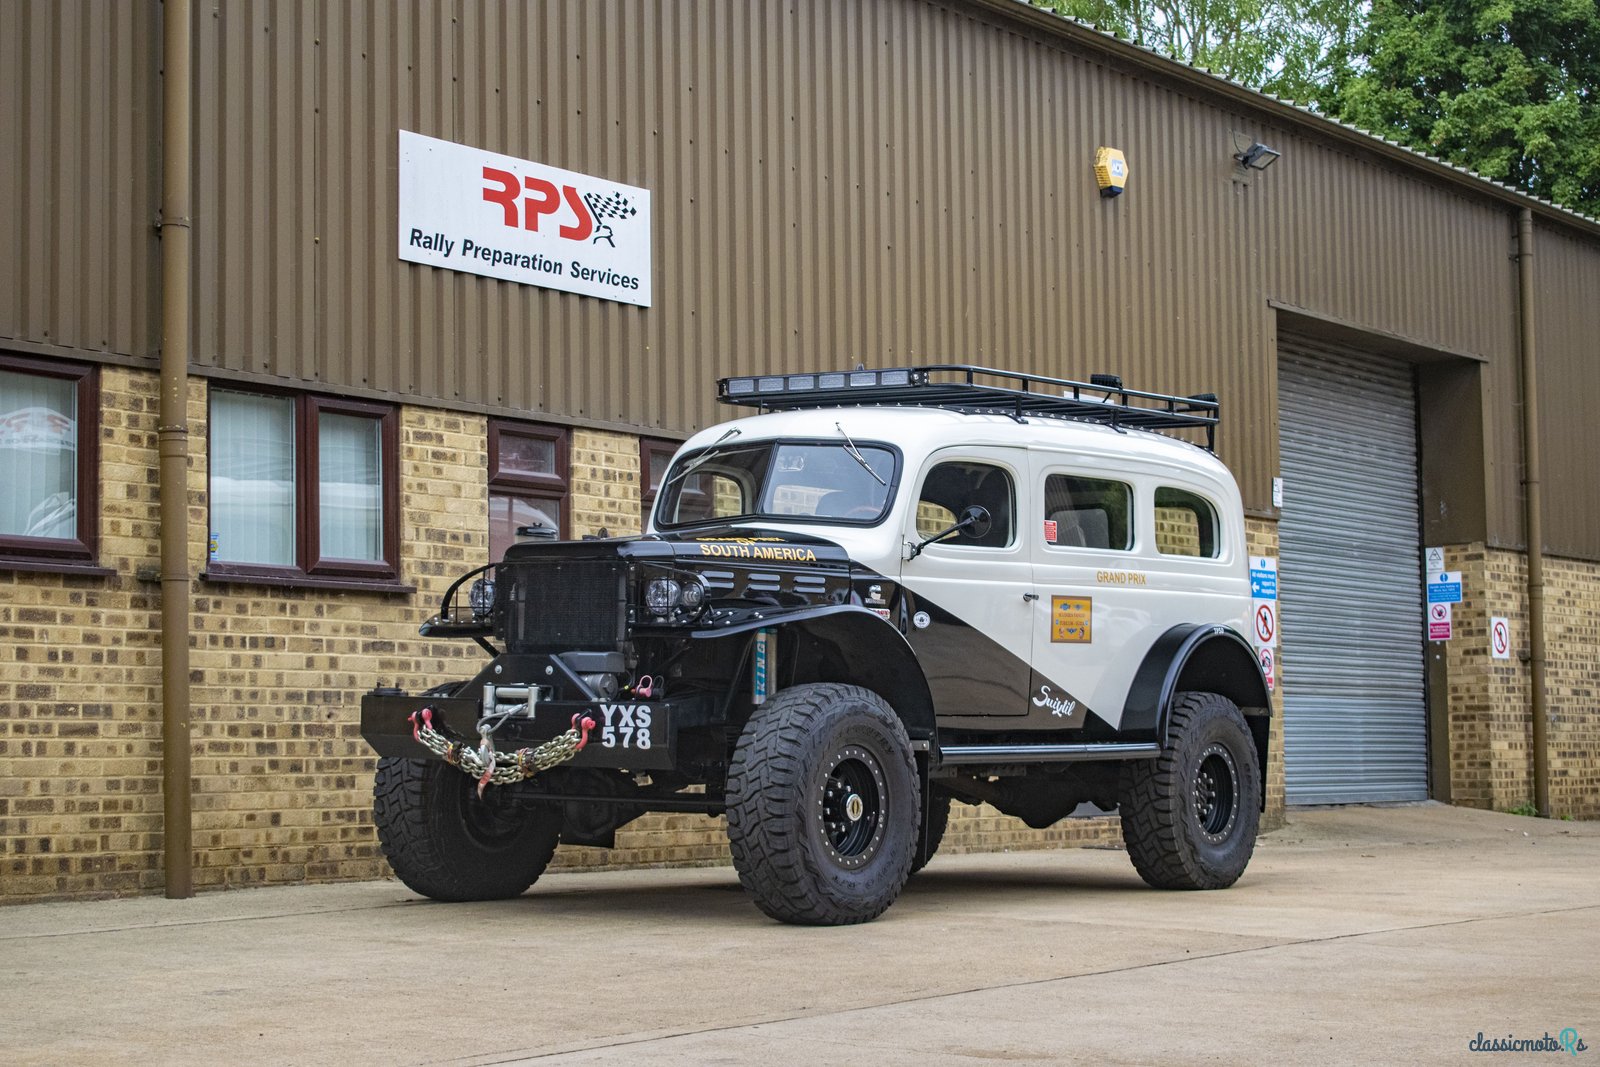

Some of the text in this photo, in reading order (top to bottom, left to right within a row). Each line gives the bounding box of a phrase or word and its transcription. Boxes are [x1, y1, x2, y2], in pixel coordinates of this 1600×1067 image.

[482, 166, 593, 241] RPS
[409, 228, 640, 290] Rally Preparation Services
[700, 544, 817, 562] SOUTH AMERICA
[1096, 571, 1147, 585] GRAND PRIX
[755, 640, 767, 693] KING
[600, 704, 651, 728] YXS
[601, 727, 651, 749] 578
